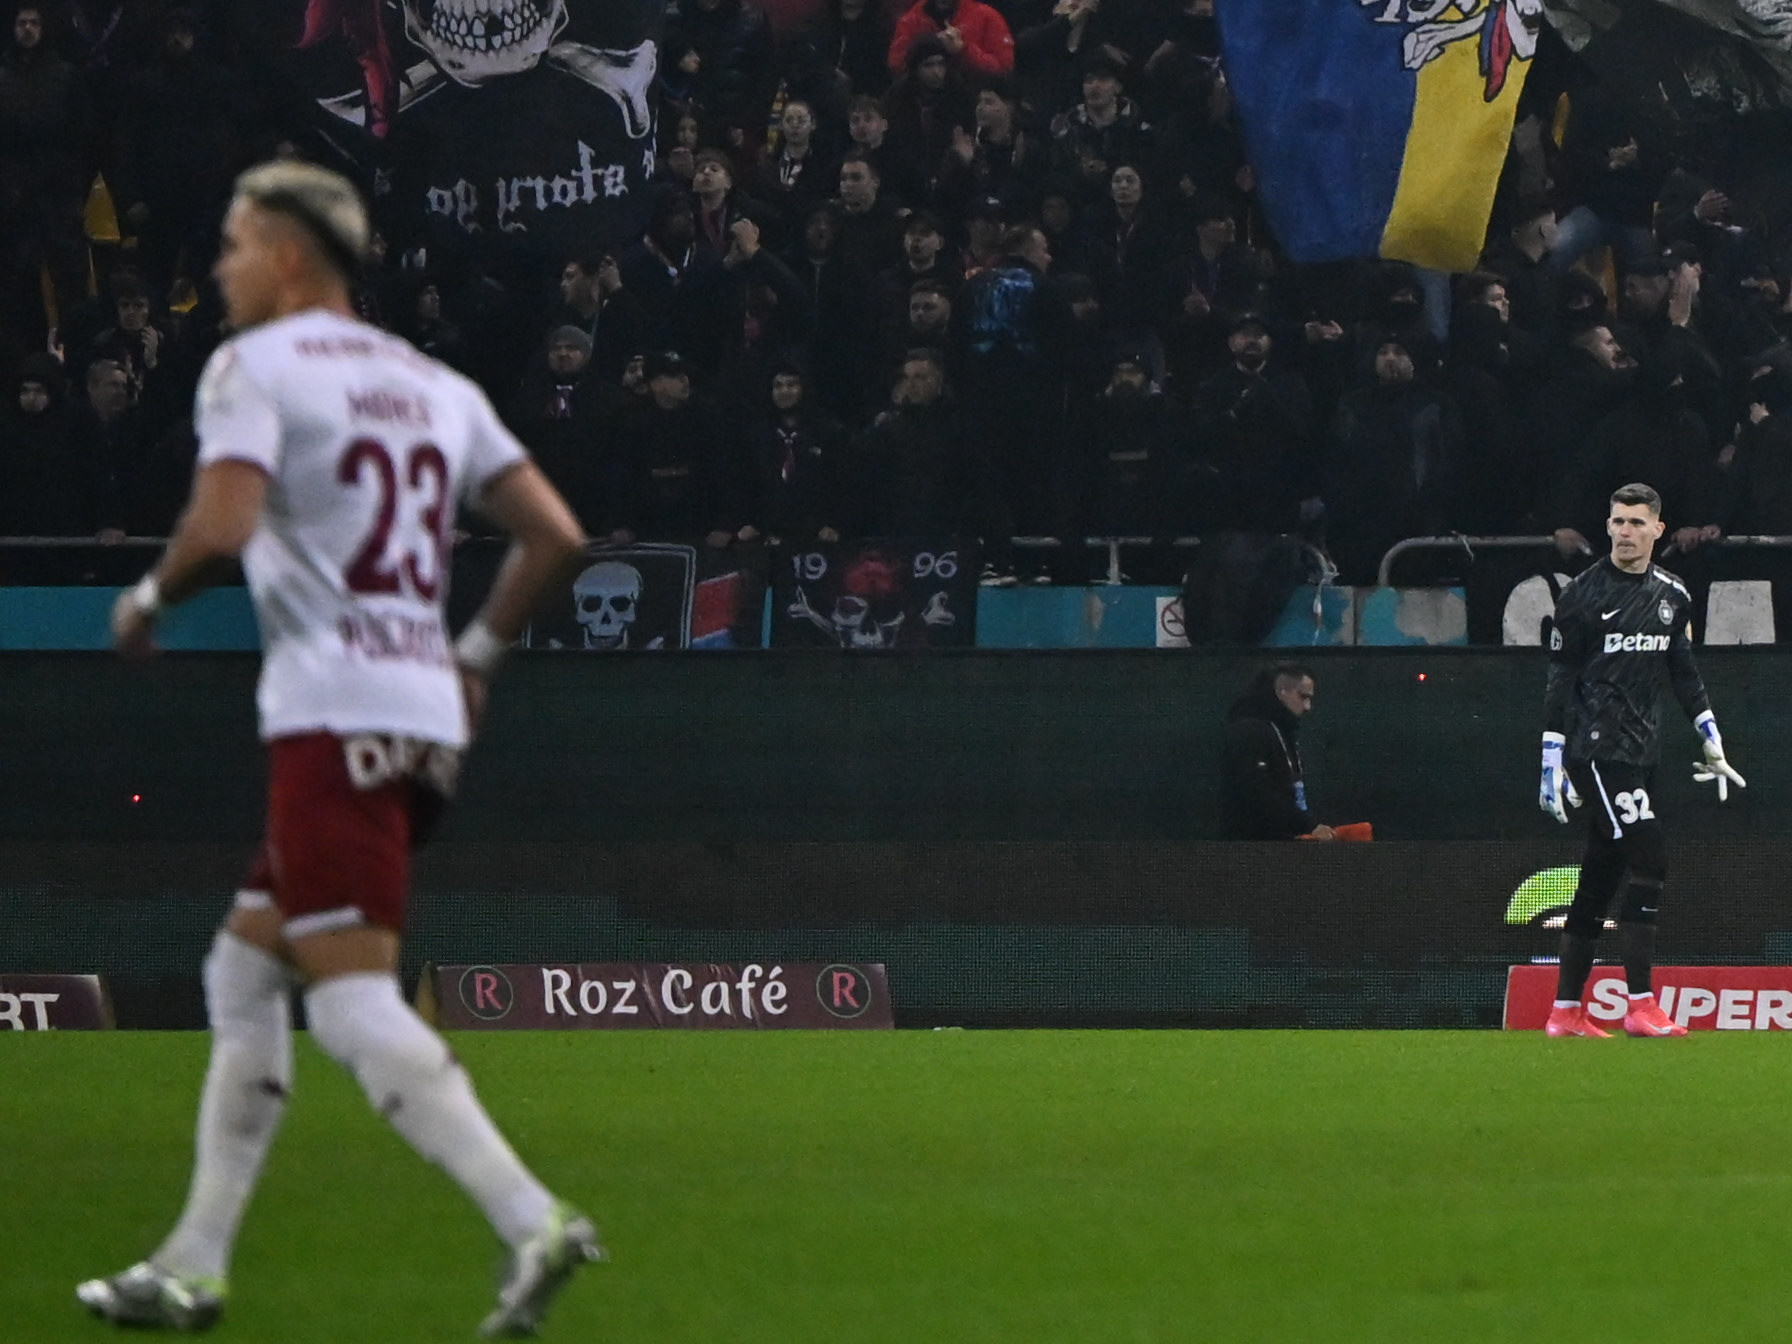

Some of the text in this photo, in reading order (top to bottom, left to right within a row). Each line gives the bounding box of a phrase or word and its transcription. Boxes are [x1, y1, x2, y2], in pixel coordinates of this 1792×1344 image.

[913, 550, 958, 579] 96
[1603, 632, 1672, 654] Betano
[1614, 787, 1656, 824] 32
[541, 967, 639, 1016] Roz
[661, 964, 788, 1019] Café
